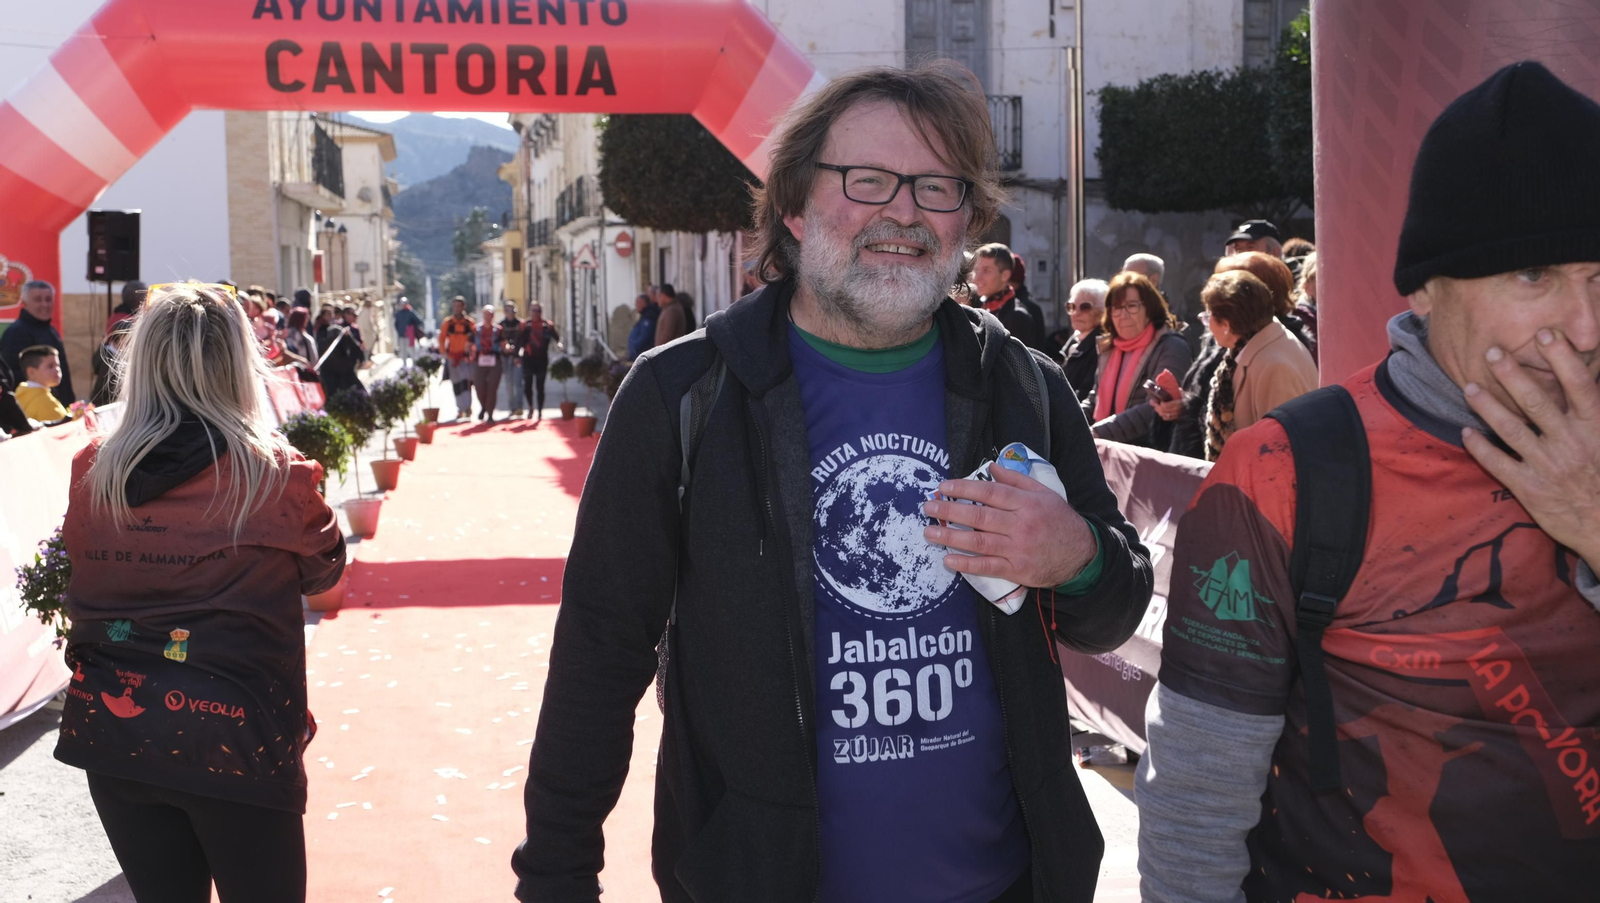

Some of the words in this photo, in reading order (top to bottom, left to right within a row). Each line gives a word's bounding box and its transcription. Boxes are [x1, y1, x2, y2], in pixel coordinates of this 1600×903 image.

[251, 0, 629, 27] AYUNTAMIENTO
[264, 39, 618, 97] CANTORIA
[810, 442, 859, 483] RUTA
[115, 551, 132, 562] DE
[1203, 570, 1252, 619] FAM
[827, 626, 972, 664] Jabalcón
[1191, 637, 1229, 653] ESCALADA
[1228, 647, 1235, 655] Y
[1197, 630, 1236, 648] DEPORTES
[1236, 641, 1248, 650] DE
[1466, 642, 1512, 690] LA
[188, 698, 246, 719] VEOLIA
[833, 735, 915, 764] ZÚJAR
[921, 743, 949, 751] Geoparque
[943, 732, 961, 741] Natural
